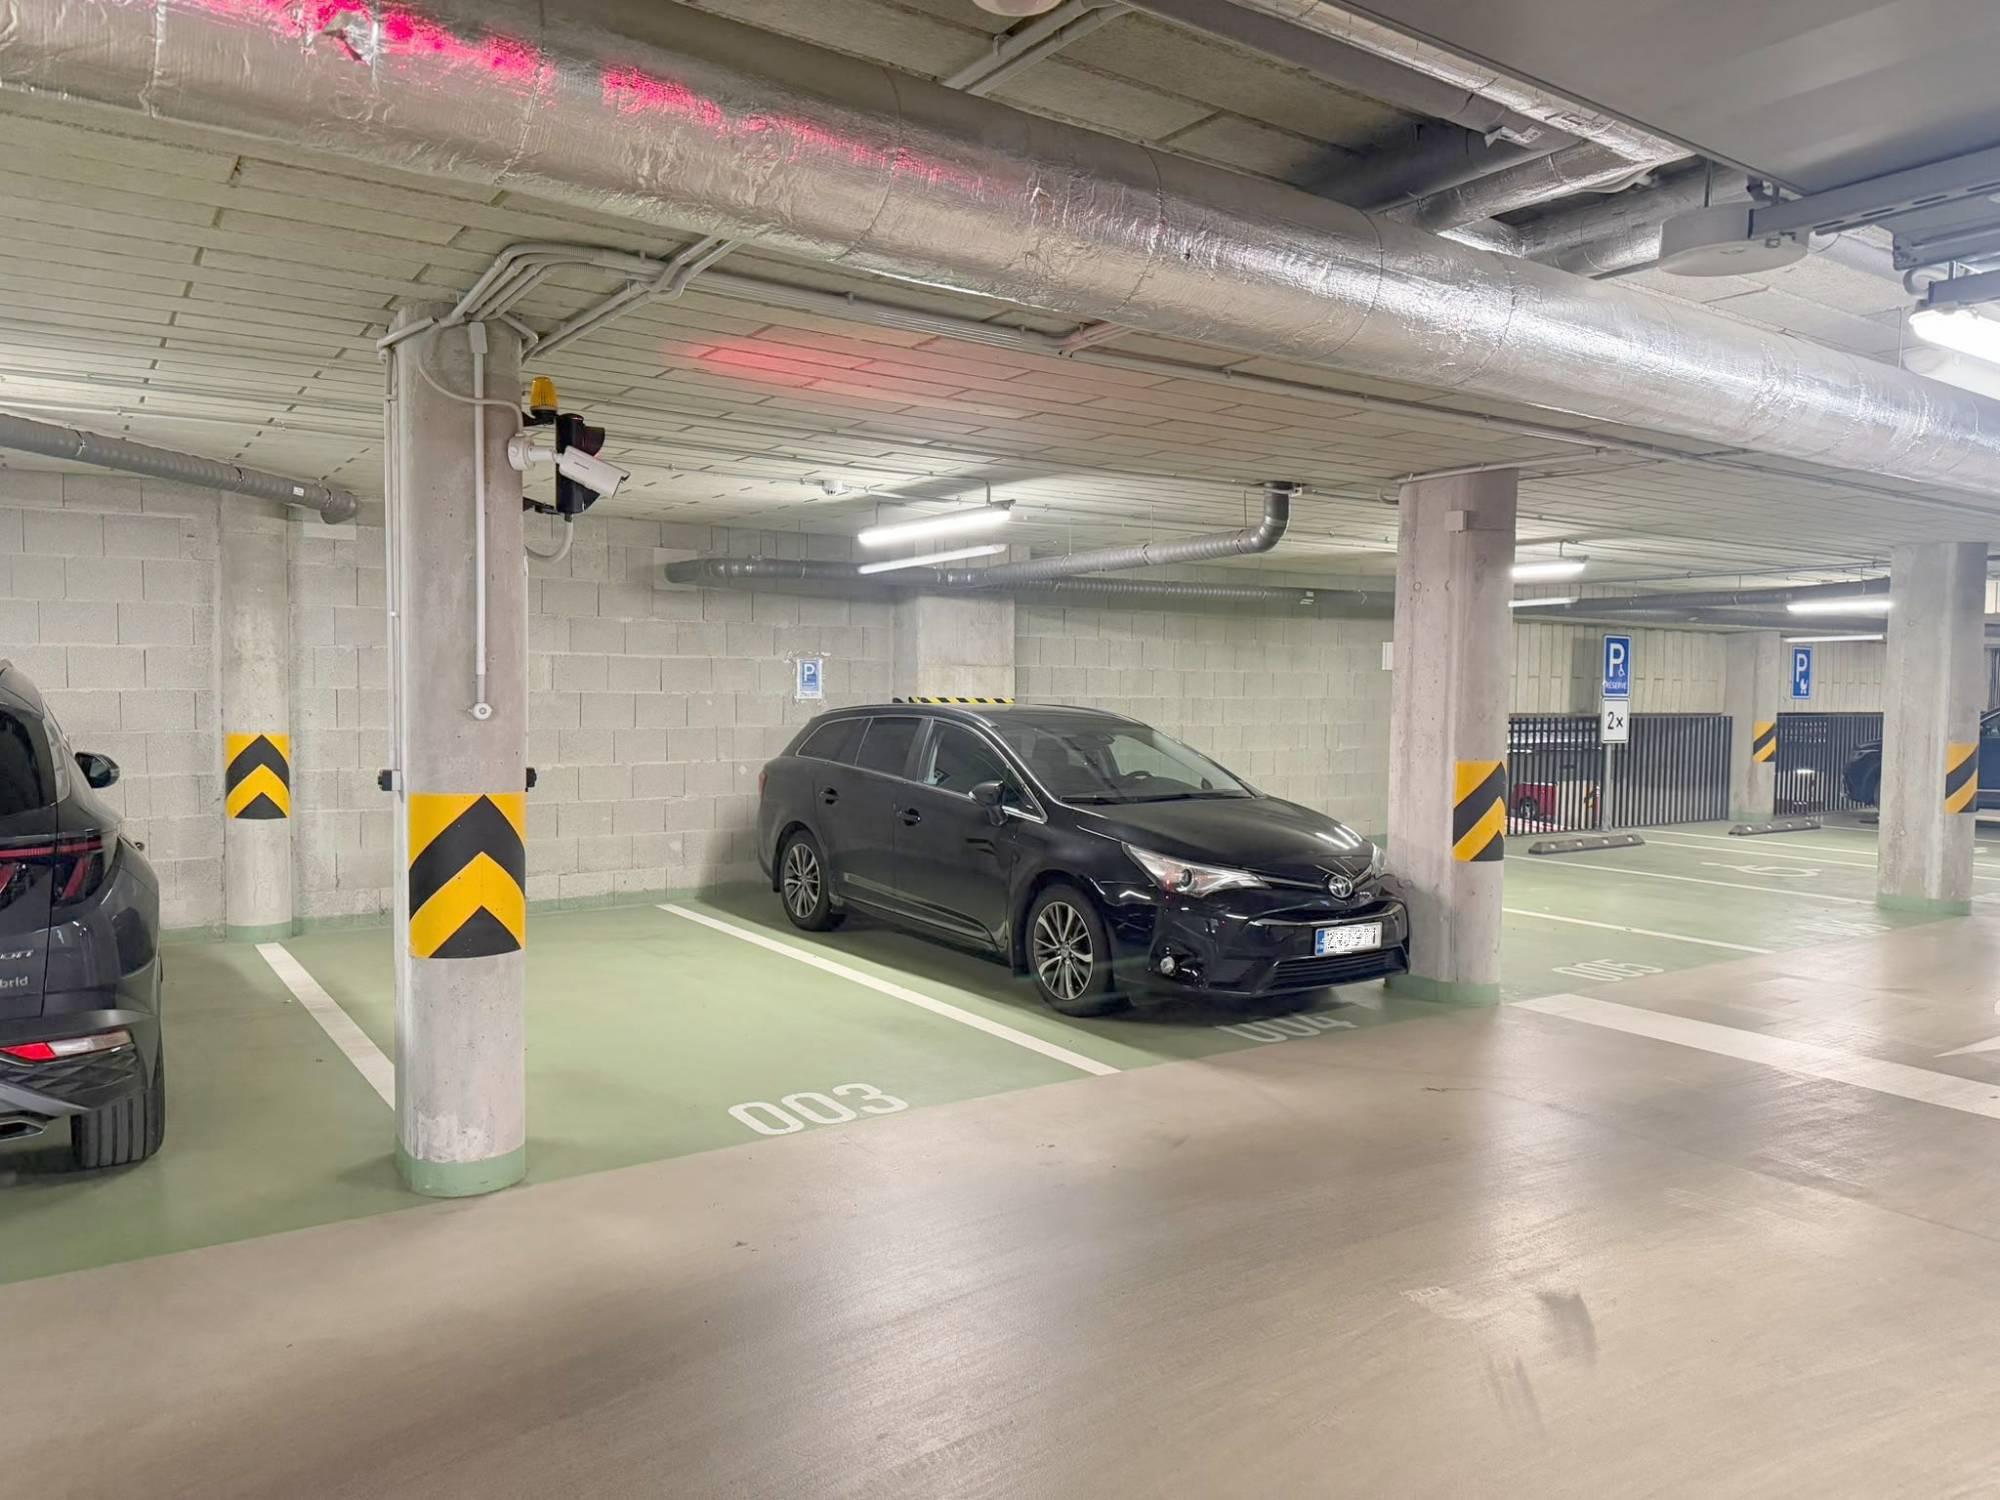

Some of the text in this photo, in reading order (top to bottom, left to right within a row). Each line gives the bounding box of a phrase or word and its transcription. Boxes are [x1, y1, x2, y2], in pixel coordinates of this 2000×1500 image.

[803, 663, 816, 681] P
[1608, 642, 1625, 677] P
[1796, 653, 1808, 683] P
[1607, 711, 1624, 730] 2x
[1551, 959, 1665, 981] 005
[1215, 1014, 1360, 1043] 004
[727, 1082, 909, 1136] 003
